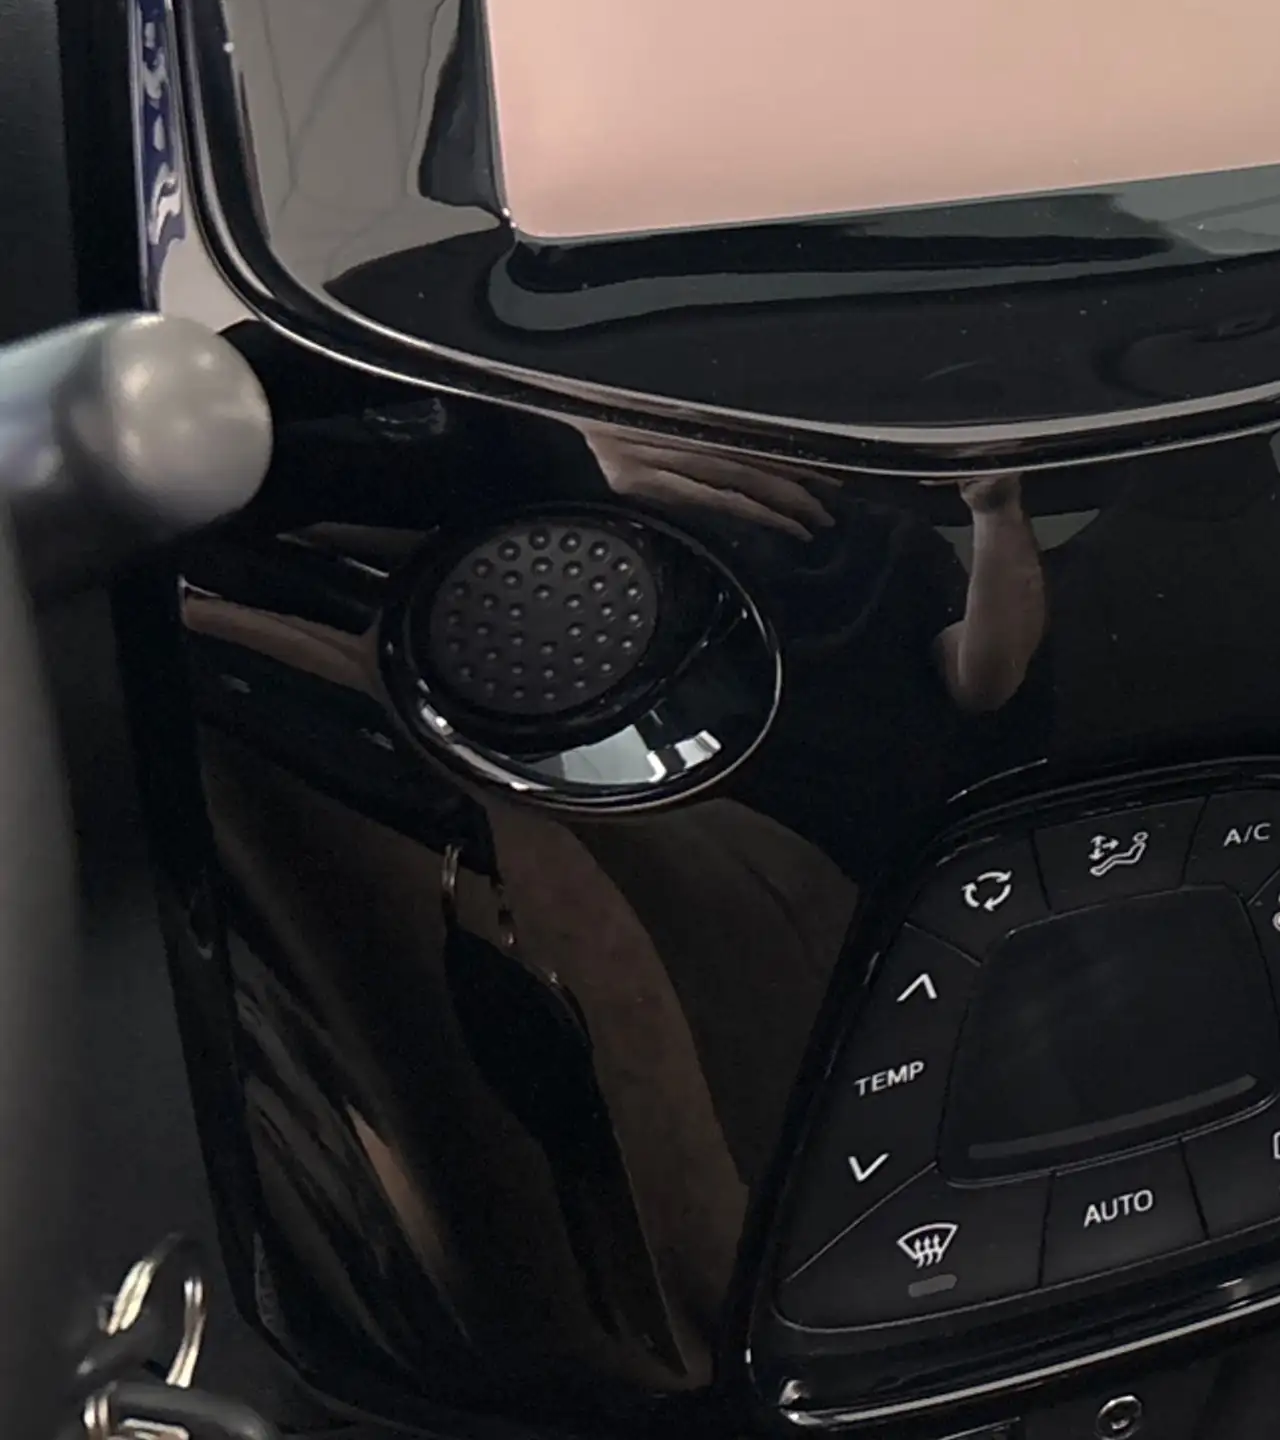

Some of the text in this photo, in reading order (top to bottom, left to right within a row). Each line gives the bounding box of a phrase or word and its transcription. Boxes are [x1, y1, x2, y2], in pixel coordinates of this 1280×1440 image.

[1223, 822, 1271, 847] A/C
[853, 1060, 925, 1097] TEMP
[1083, 1188, 1154, 1229] AUTO
